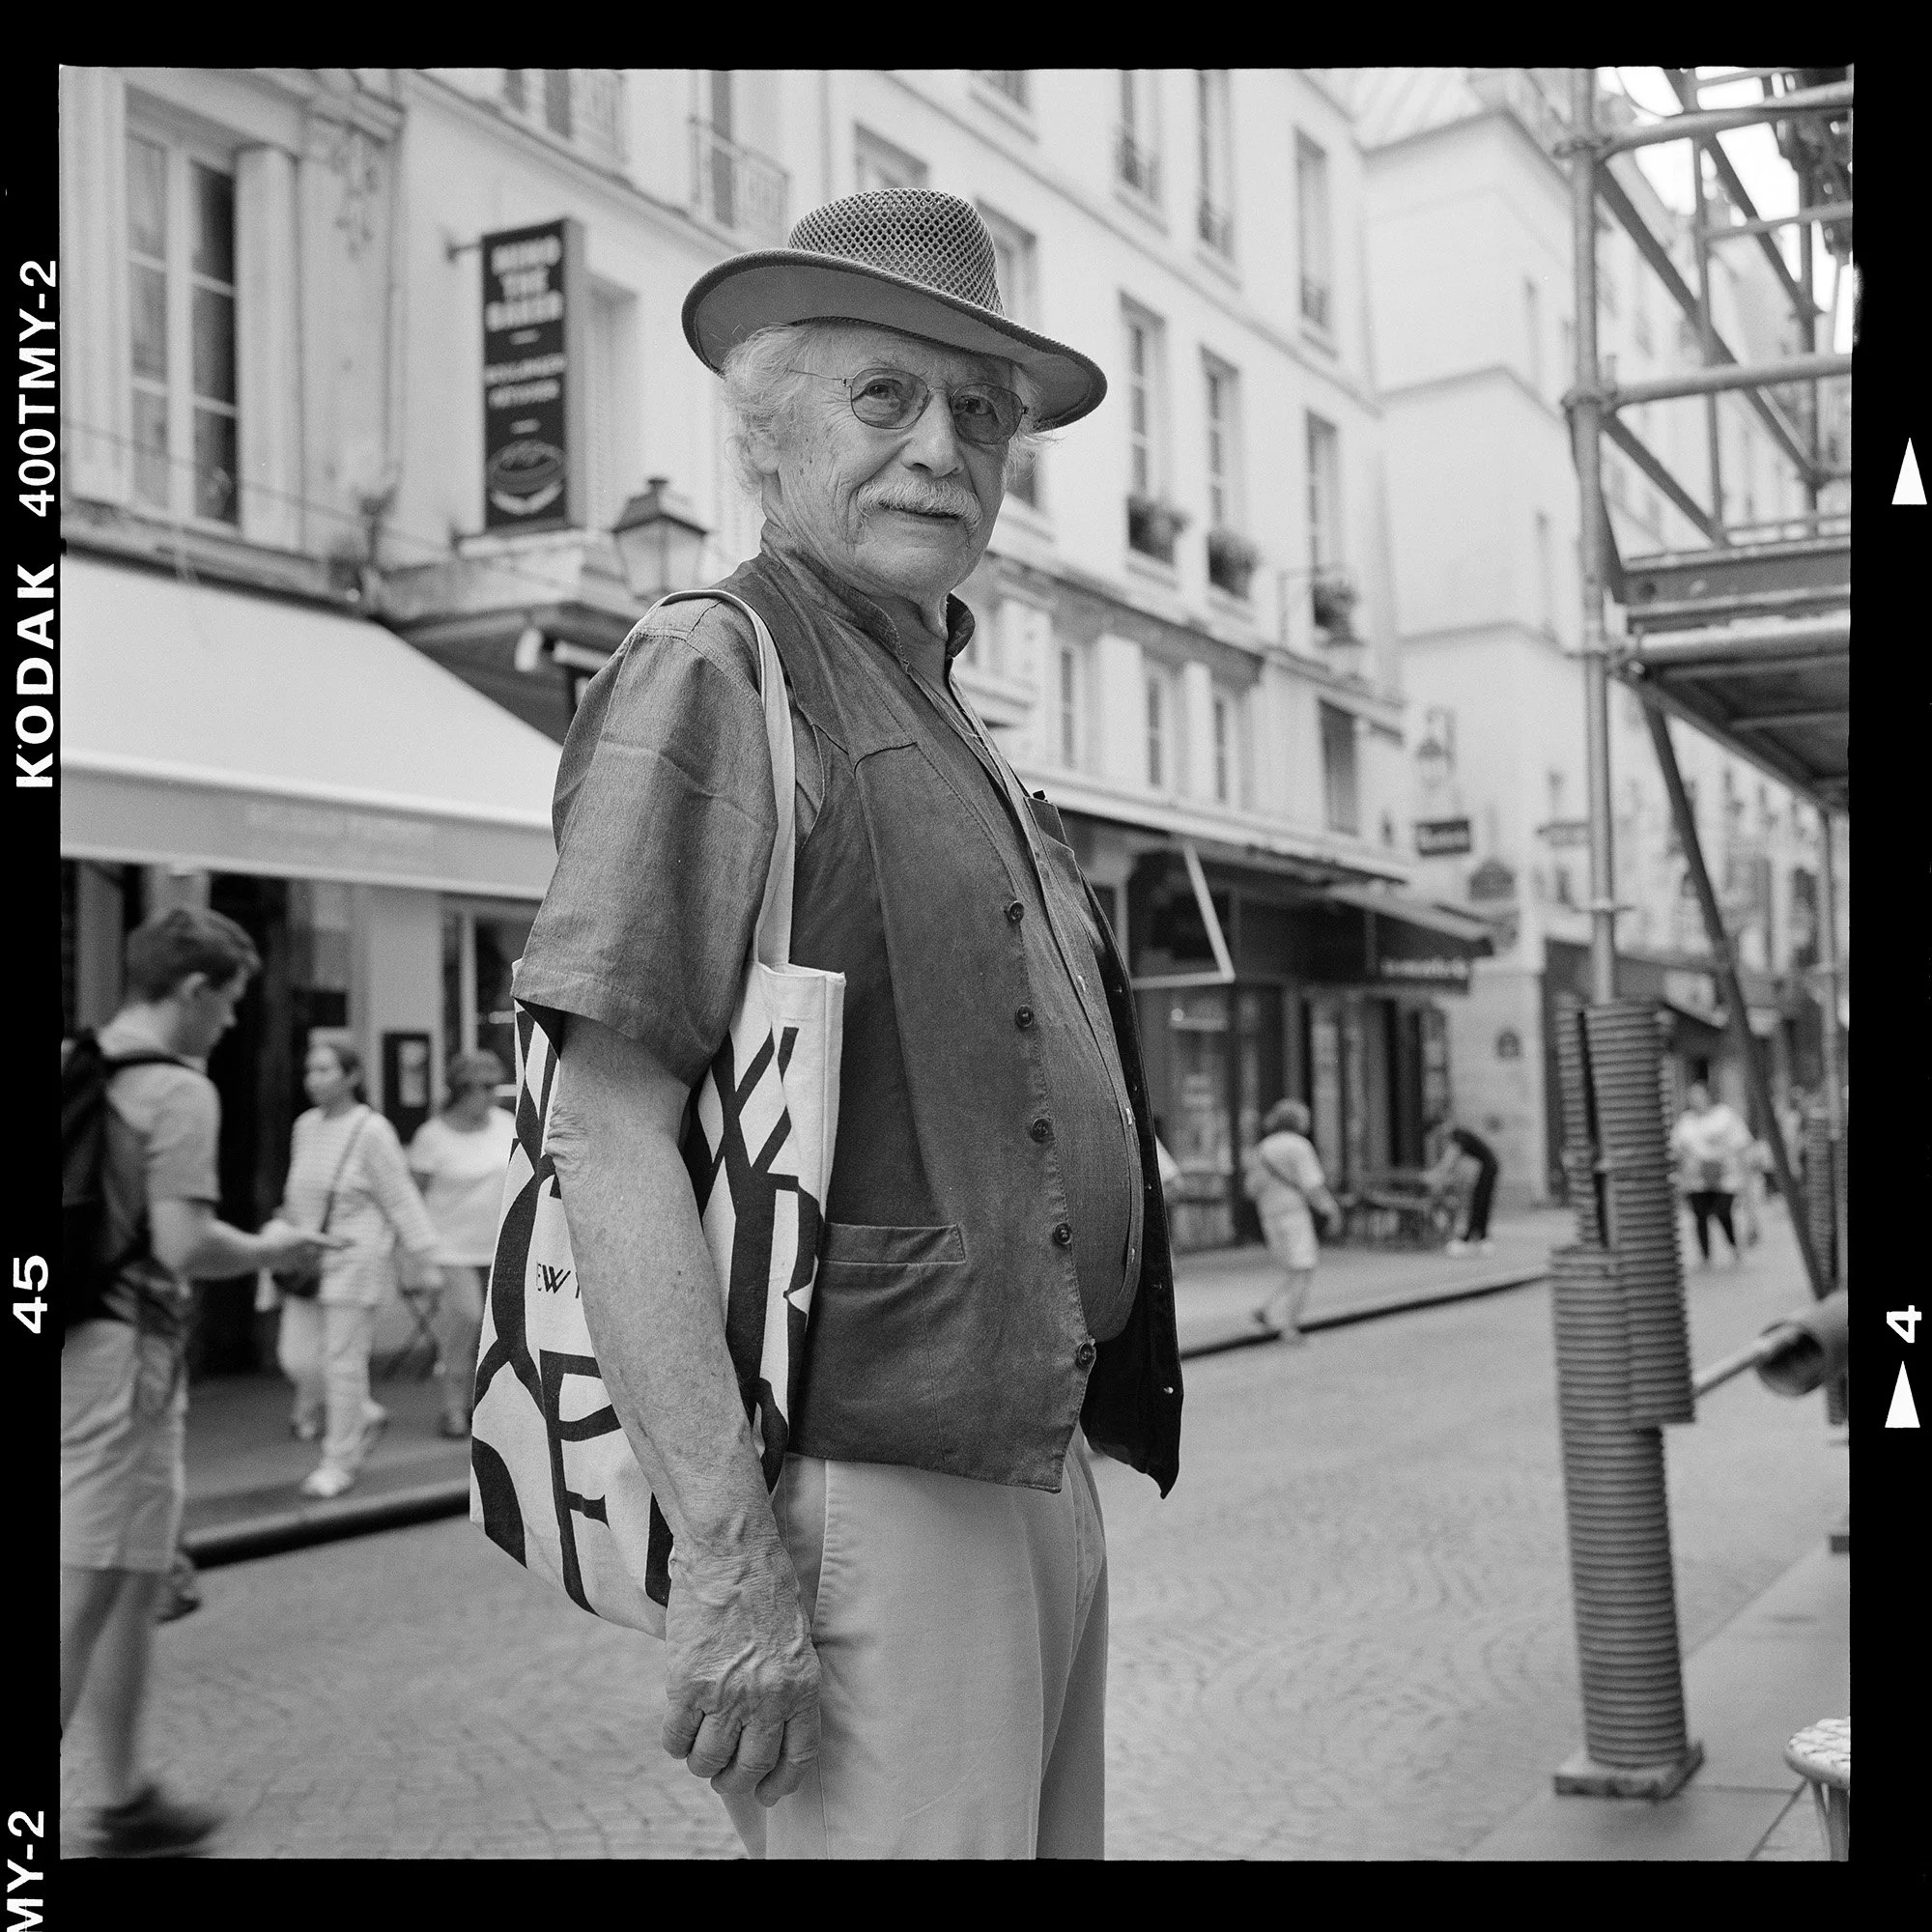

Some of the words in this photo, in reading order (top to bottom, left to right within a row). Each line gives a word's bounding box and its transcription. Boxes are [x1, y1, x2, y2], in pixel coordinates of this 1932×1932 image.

[18, 260, 57, 518] 400TMY-2
[15, 563, 55, 788] KODAK
[12, 1255, 49, 1334] 45
[1886, 1304, 1922, 1344] 4
[6, 1810, 44, 1932] MY-2
